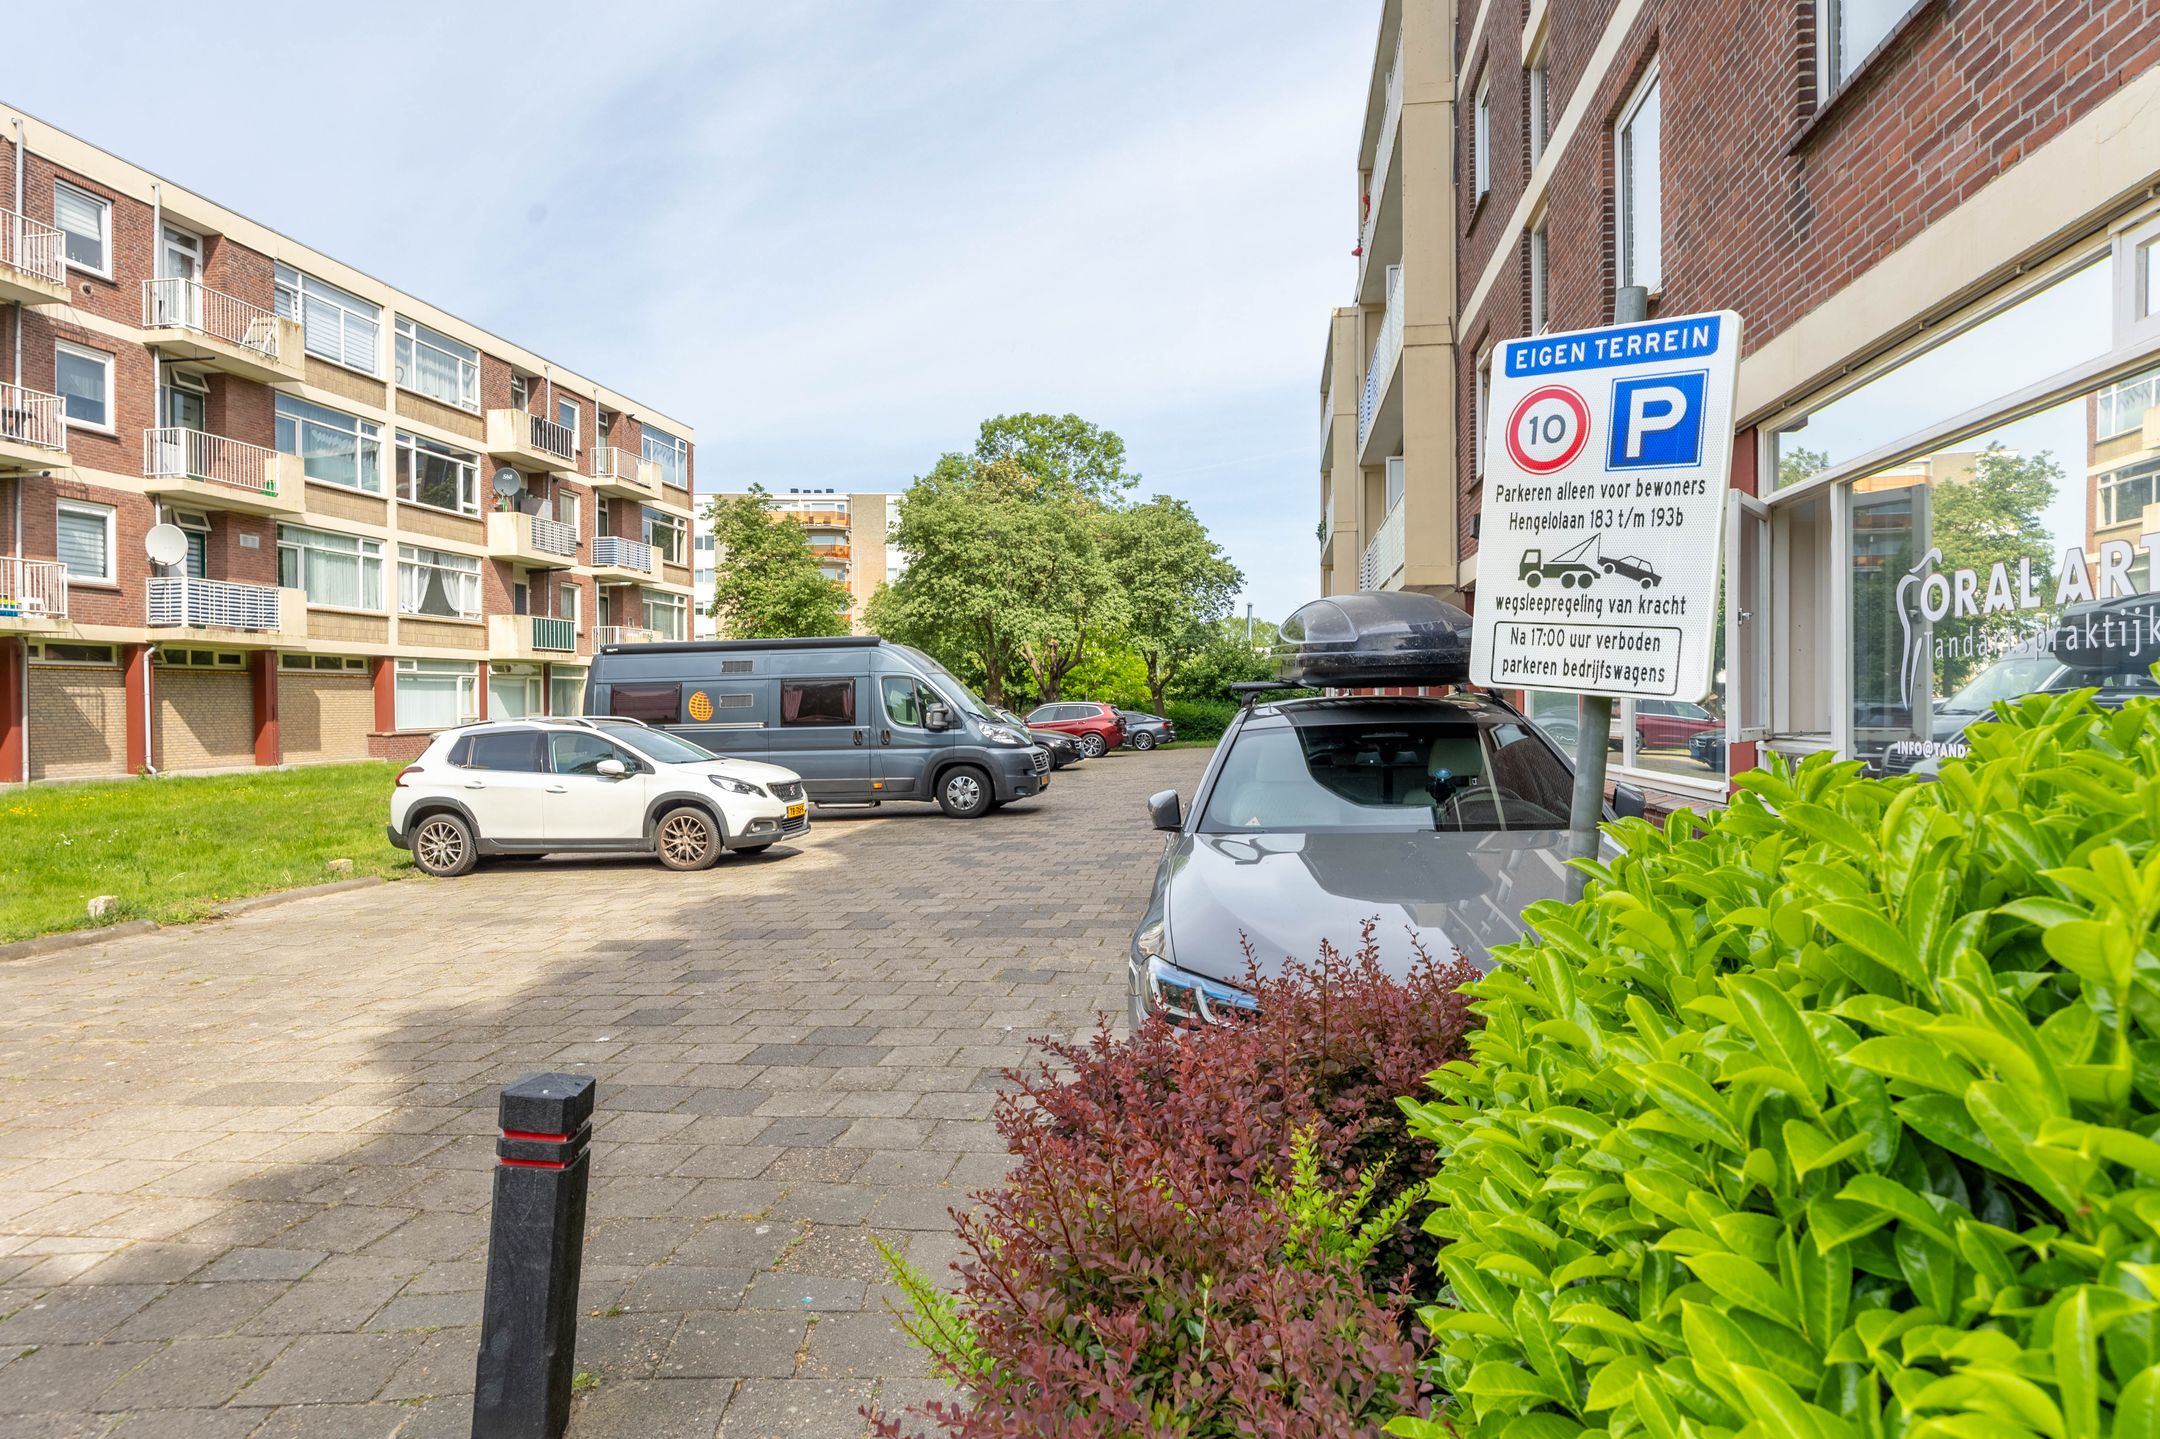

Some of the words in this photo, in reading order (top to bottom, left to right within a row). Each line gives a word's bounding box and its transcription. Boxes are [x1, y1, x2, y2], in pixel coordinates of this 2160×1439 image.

[1515, 342, 1586, 370] EIGEN
[1594, 325, 1709, 360] TERREIN
[1529, 414, 1566, 445] 10
[1626, 386, 1687, 458] P
[1496, 485, 1552, 503] Parkeren
[1557, 481, 1595, 499] alleen
[1600, 481, 1631, 499] voor
[1636, 478, 1706, 497] bewoners
[1509, 511, 1585, 535] Hengelolaan
[1590, 510, 1613, 528] 183
[1618, 506, 1645, 528] t/m
[1651, 507, 1684, 527] 193b
[1920, 556, 2042, 622] ORAL
[1495, 592, 1603, 619] wegsleepregeling
[1609, 597, 1632, 614] van
[1638, 594, 1686, 615] kracht
[1510, 627, 1526, 646] Na
[1531, 628, 1565, 647] 17:00
[1569, 632, 1592, 649] uur
[1596, 632, 1661, 652] verboden
[1502, 656, 1557, 677] parkeren
[1562, 659, 1665, 686] bedrijfswagens
